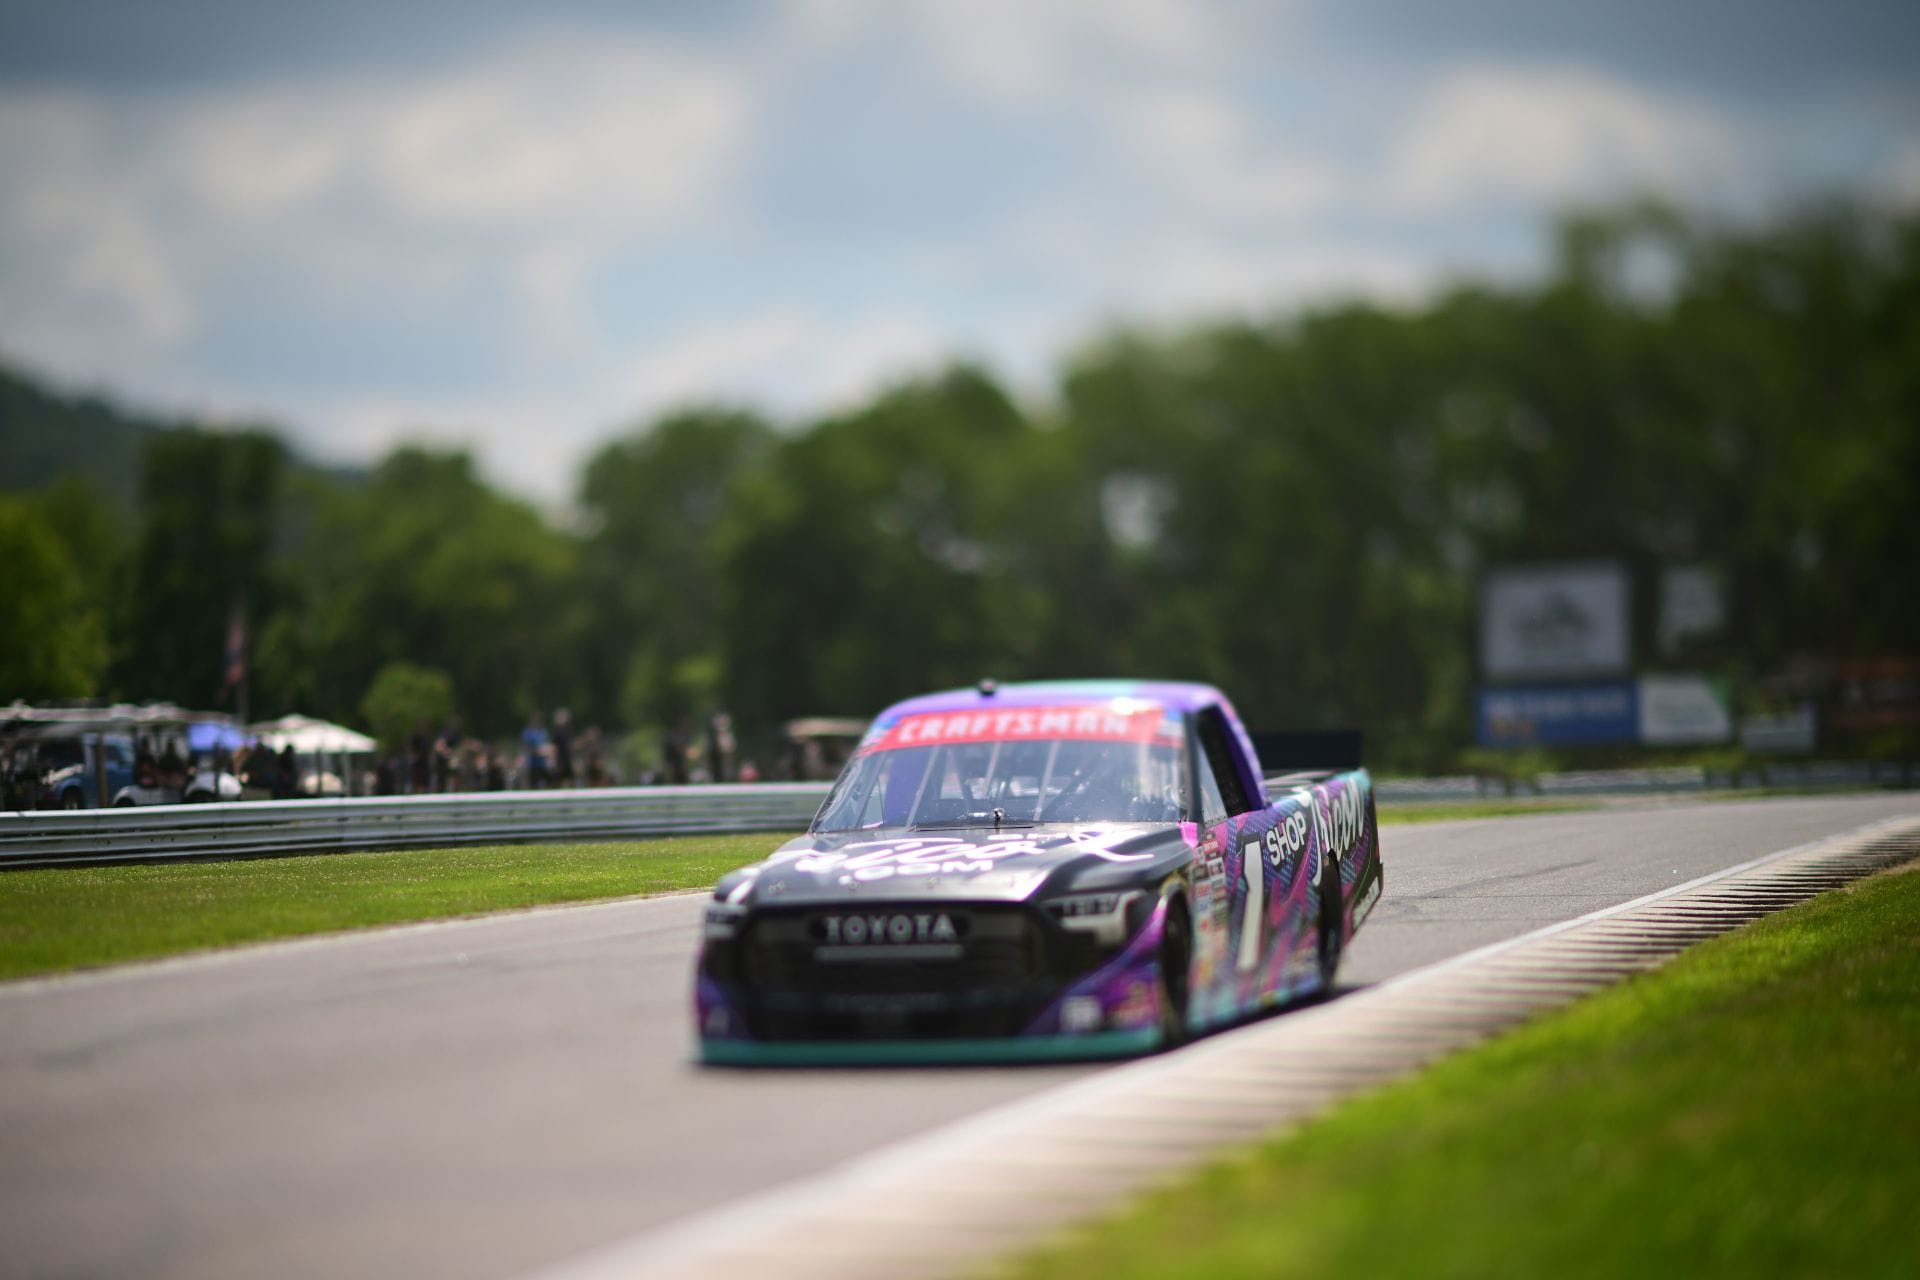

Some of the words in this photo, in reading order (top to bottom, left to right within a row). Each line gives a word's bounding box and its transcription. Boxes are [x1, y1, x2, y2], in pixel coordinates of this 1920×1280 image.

[897, 710, 1129, 742] CRAFTSMAN
[1266, 811, 1307, 866] SHOP
[839, 860, 994, 885] .COM
[1238, 841, 1264, 972] 1
[825, 914, 957, 943] TOYOTA
